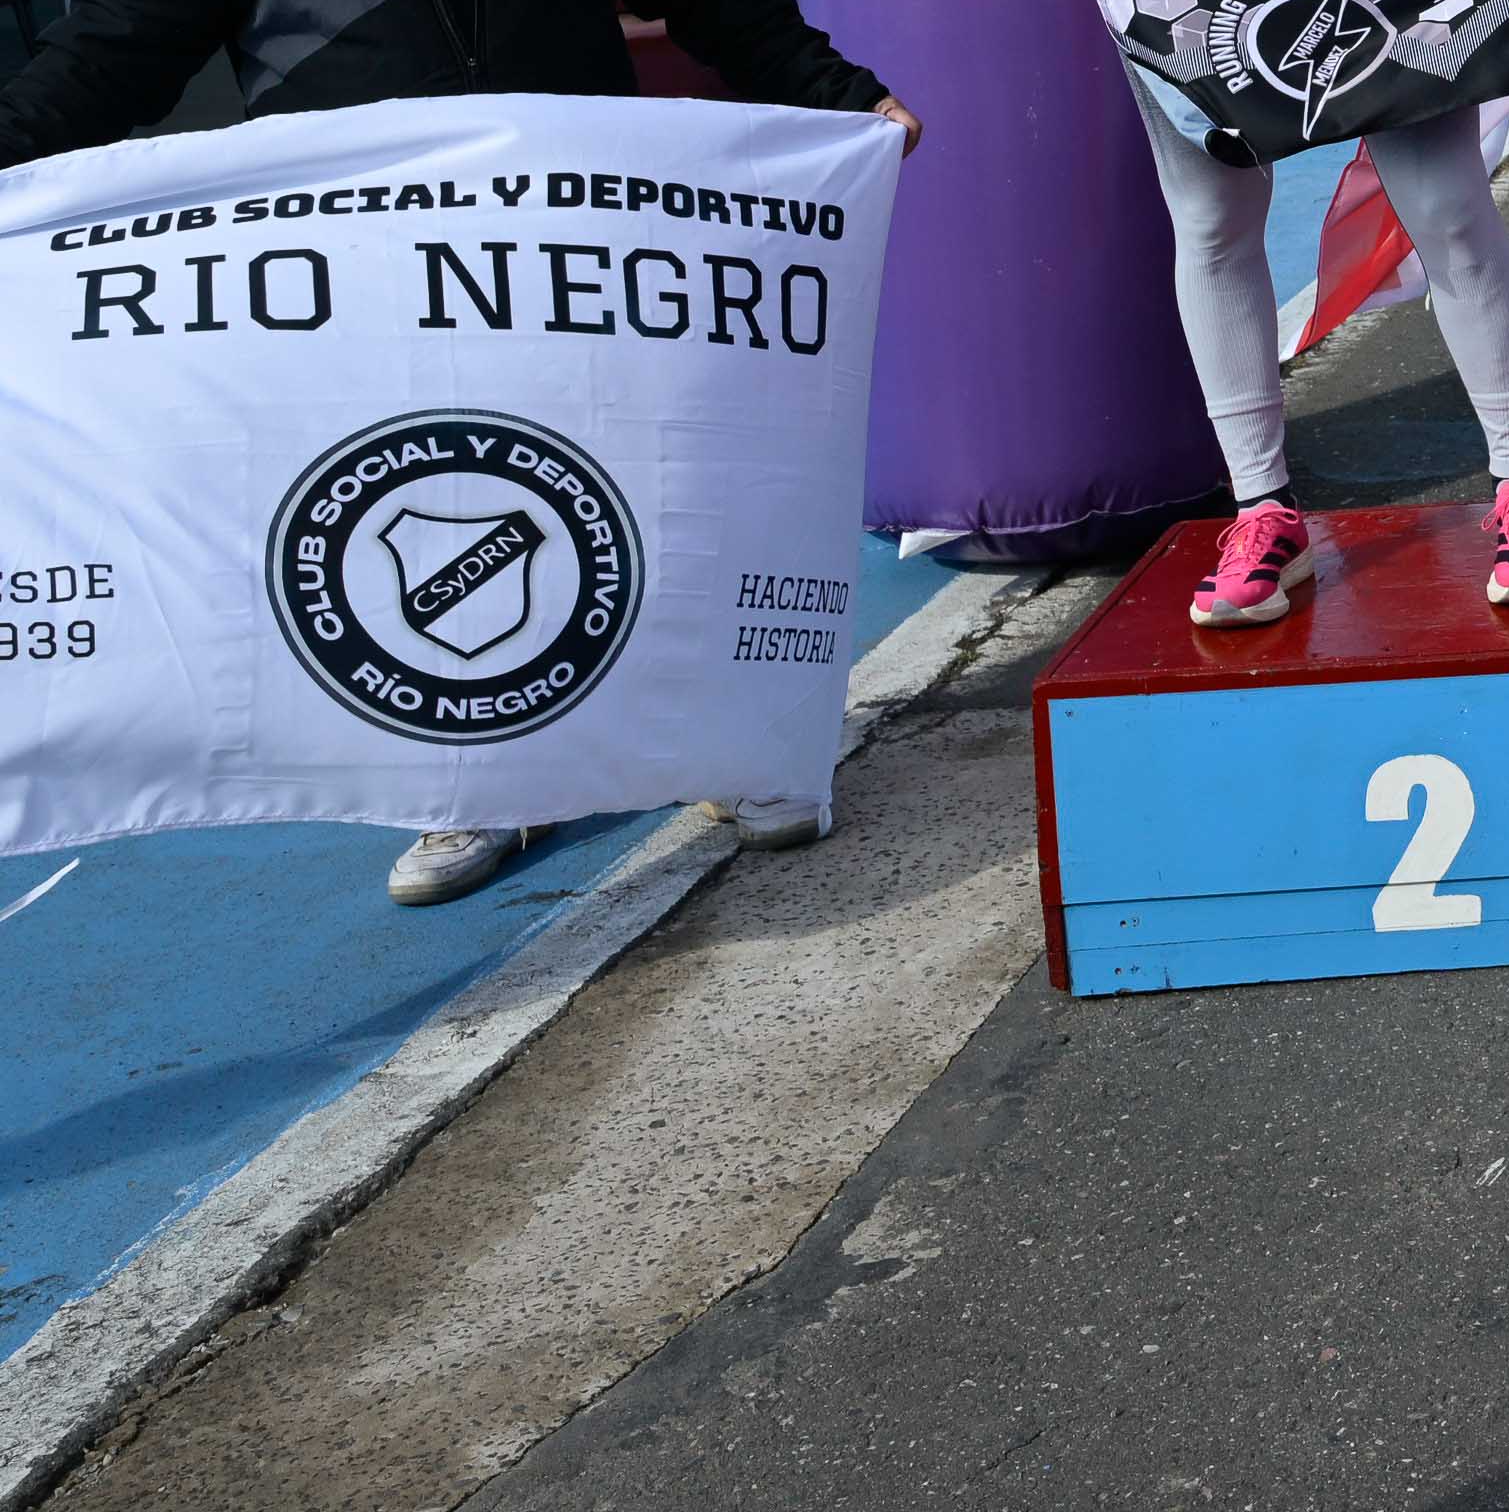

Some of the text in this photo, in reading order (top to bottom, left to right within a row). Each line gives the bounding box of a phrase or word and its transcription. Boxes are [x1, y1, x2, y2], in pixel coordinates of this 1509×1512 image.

[1293, 11, 1336, 60] MARCELO
[1311, 44, 1348, 88] MENDEZ
[49, 171, 846, 252] CLUB SOCIAL Y DEPORTIVO
[70, 240, 829, 356] RIO NEGRO
[297, 434, 621, 641] CLUB SOCIAL Y DEPORTIVO
[0, 564, 115, 603] SDE
[412, 525, 526, 614] CSyDRN
[736, 573, 849, 615] HACIENDO
[733, 626, 836, 664] HISTORIA
[350, 661, 576, 720] RÍO NEGRO
[1364, 753, 1482, 933] 2
